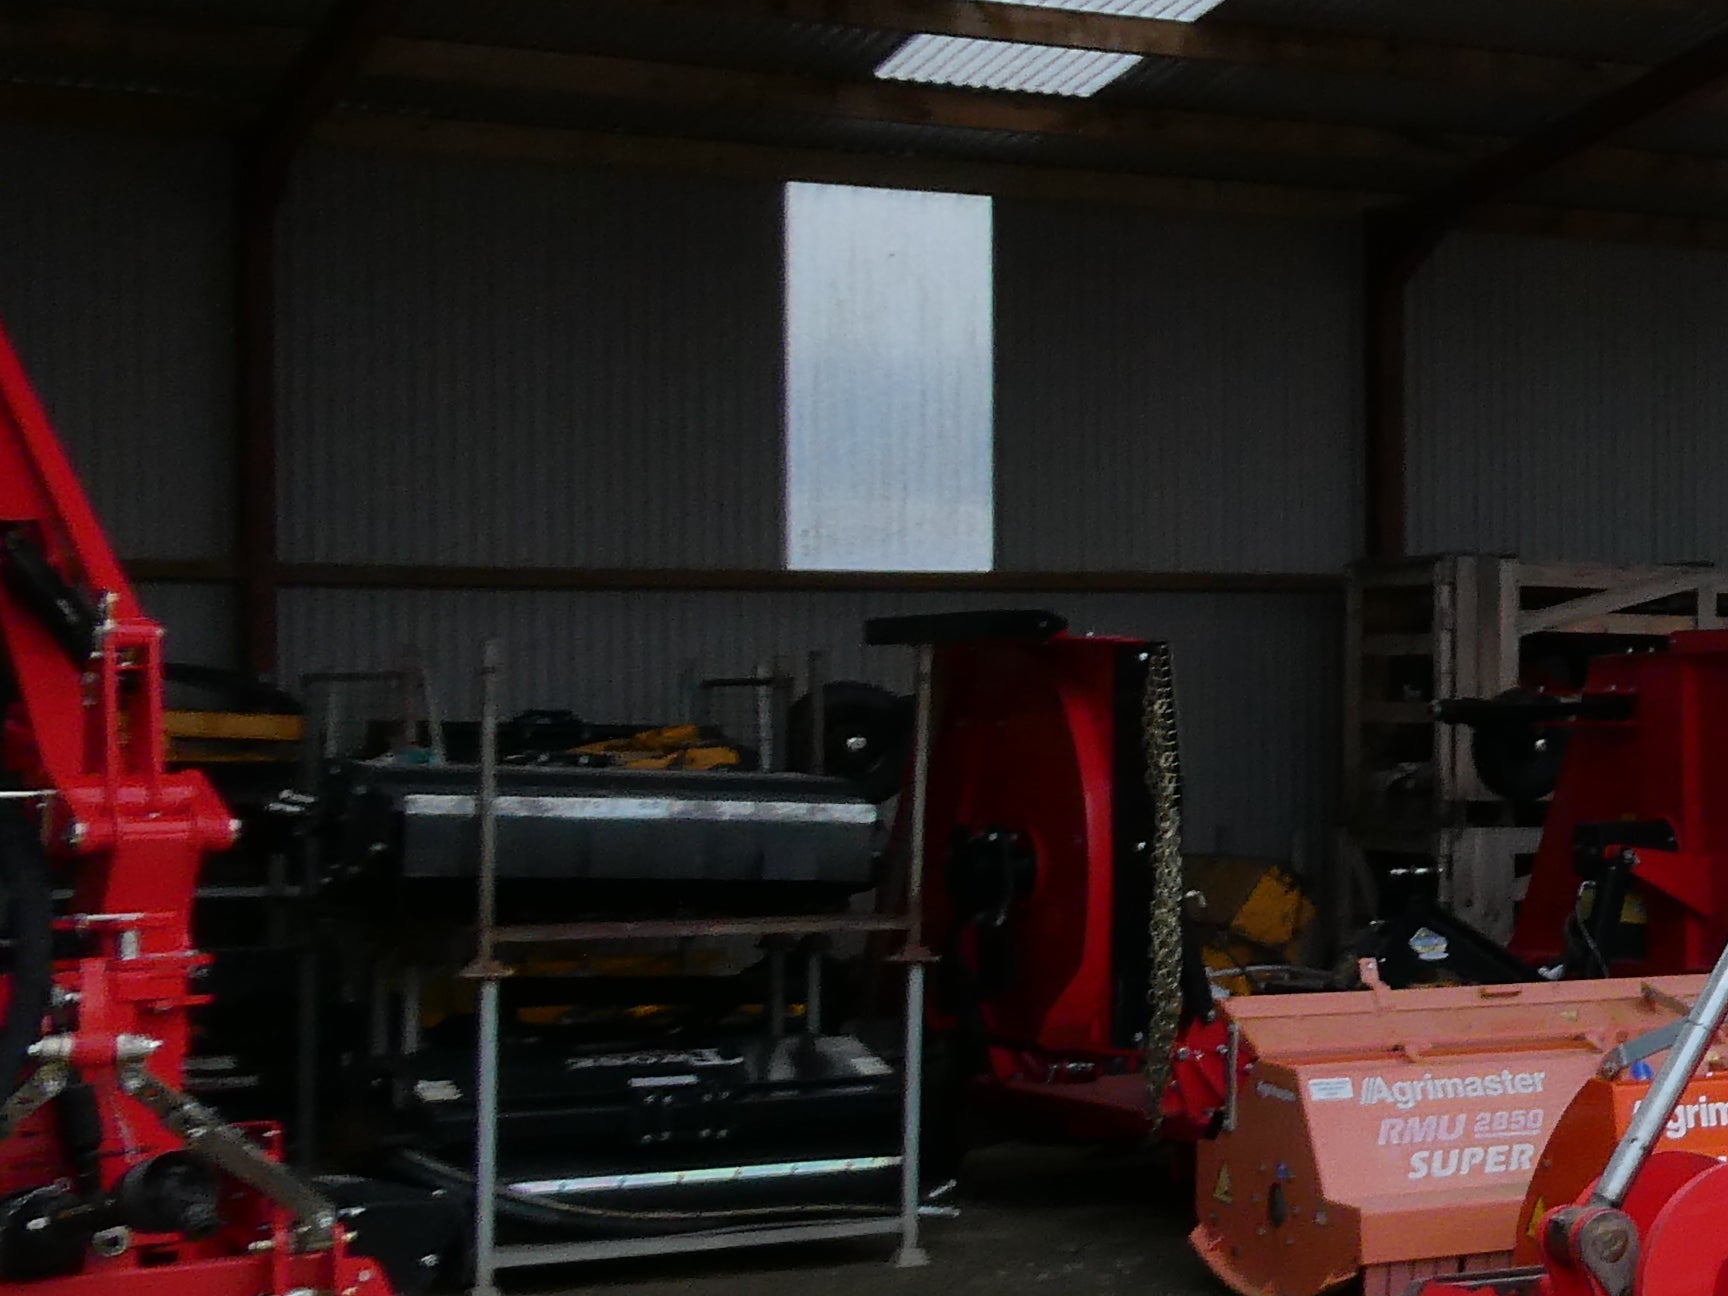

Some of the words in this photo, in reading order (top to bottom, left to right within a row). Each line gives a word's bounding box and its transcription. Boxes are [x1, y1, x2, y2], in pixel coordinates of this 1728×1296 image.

[1360, 1069, 1546, 1110] Agrimaster
[1377, 1113, 1468, 1146] RMU
[1473, 1108, 1545, 1138] 2850
[1407, 1142, 1536, 1181] SUPER
